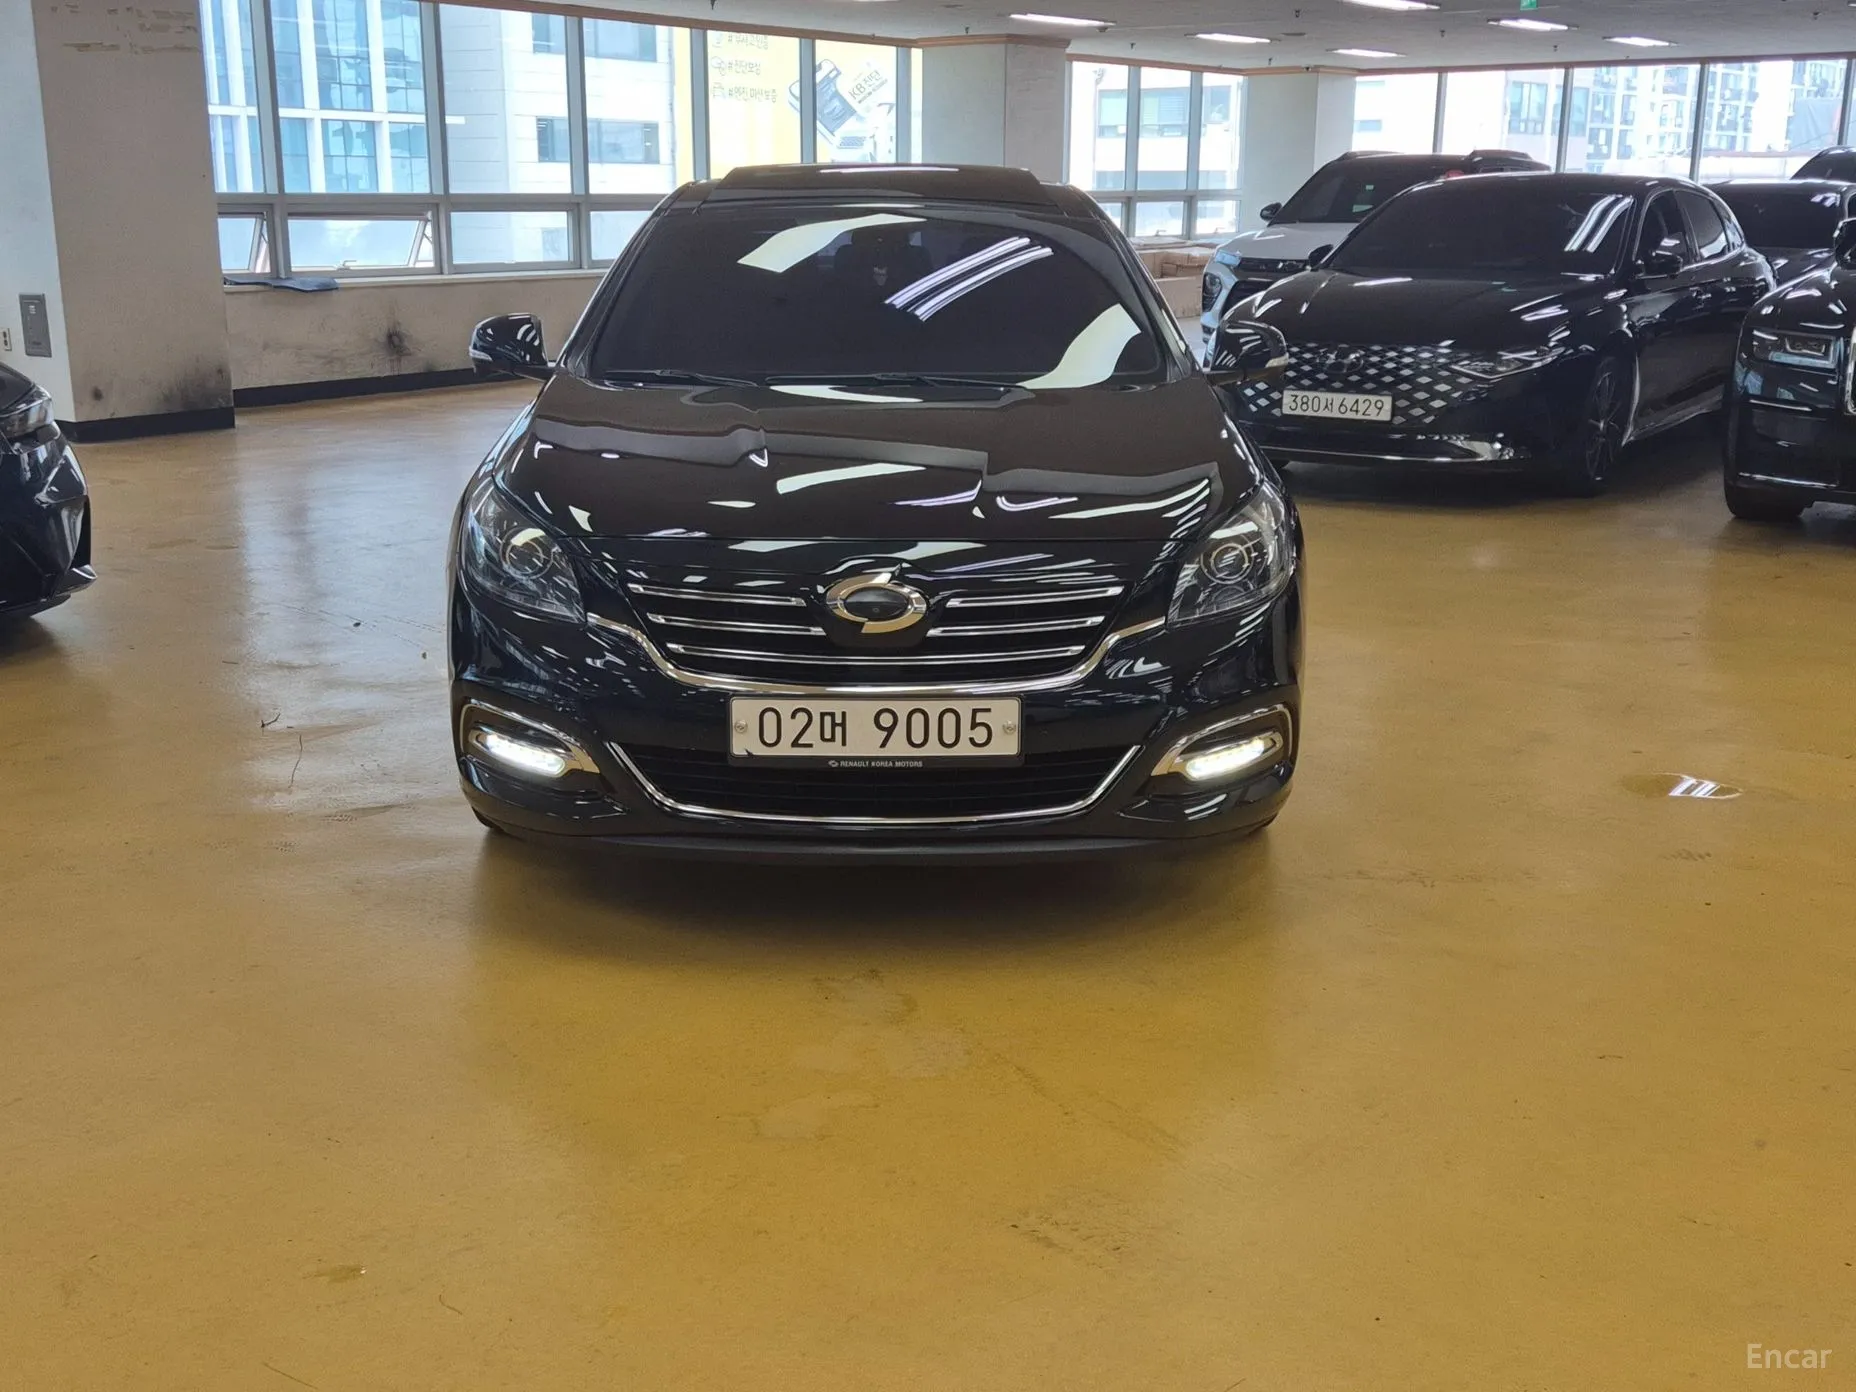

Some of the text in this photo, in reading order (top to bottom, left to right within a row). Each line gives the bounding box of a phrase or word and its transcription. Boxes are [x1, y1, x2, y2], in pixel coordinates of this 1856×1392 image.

[848, 83, 866, 100] KB
[1289, 394, 1384, 416] 380서6429
[758, 707, 993, 749] 02머 9005
[840, 760, 923, 768] RENAULT KOREA MOTORS
